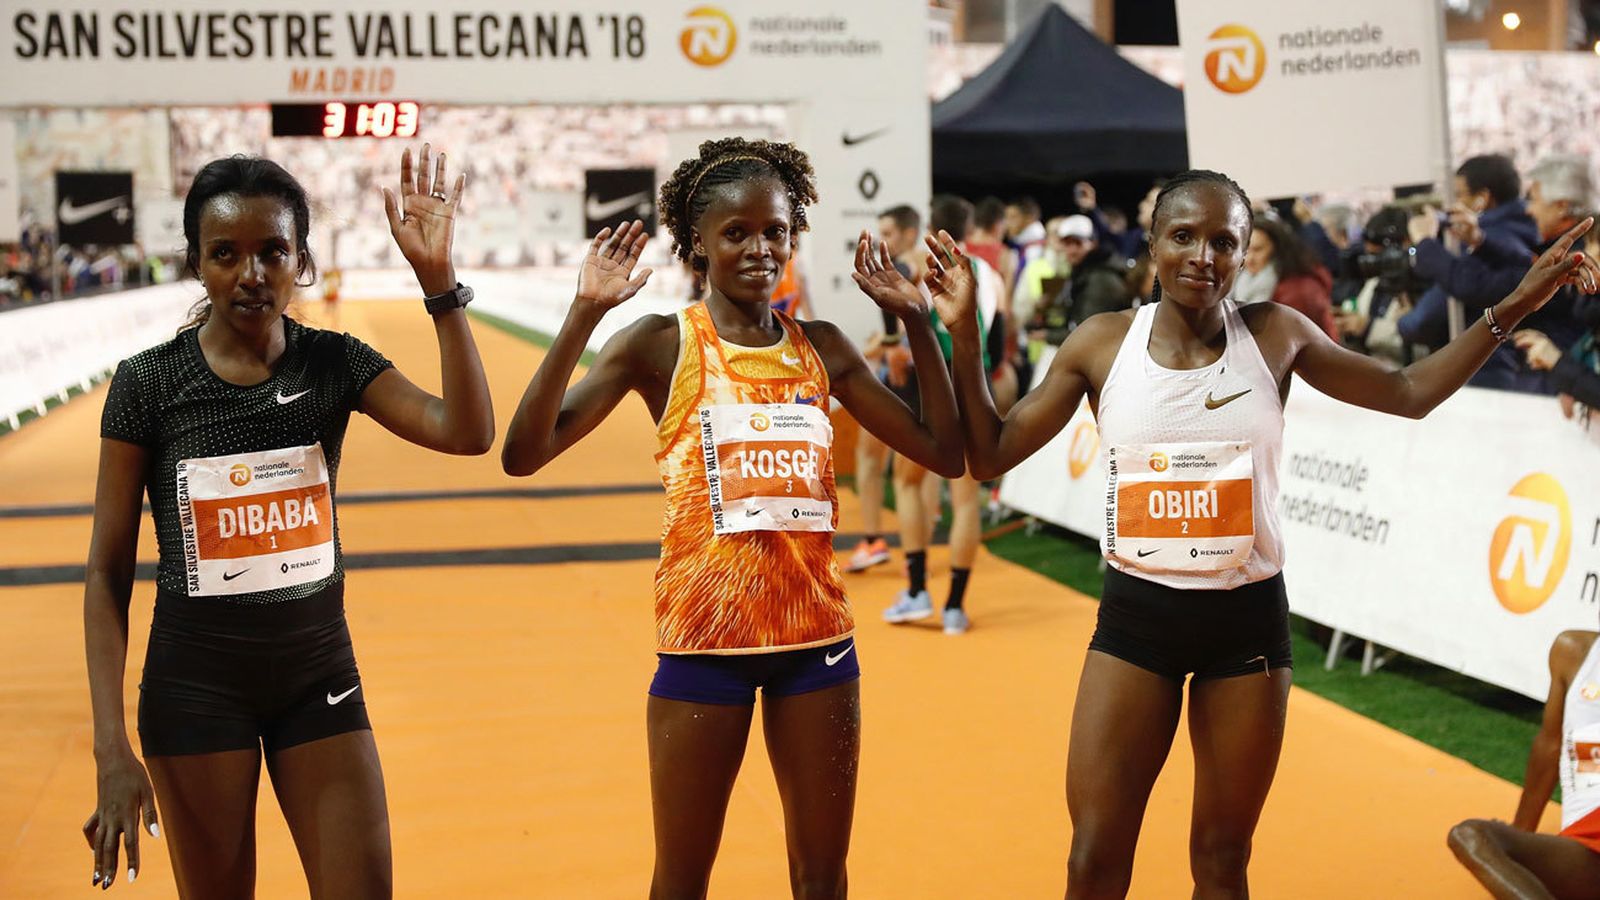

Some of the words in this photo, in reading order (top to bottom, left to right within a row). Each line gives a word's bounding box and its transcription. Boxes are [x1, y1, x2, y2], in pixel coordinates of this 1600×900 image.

[14, 12, 99, 59] SAN
[113, 12, 334, 59] SILVESTRE
[348, 13, 589, 59] VALLECANA
[597, 14, 646, 58] '18
[749, 15, 847, 33] nationale
[1279, 22, 1383, 50] nationale
[749, 36, 881, 56] nederlanden
[1281, 45, 1421, 77] nederlanden
[288, 66, 396, 95] MADRID
[254, 461, 290, 472] nationale
[1172, 453, 1206, 461] nationale
[1172, 460, 1218, 468] nederlanden
[254, 468, 304, 480] nederlanden
[1289, 449, 1369, 492] nationale
[785, 479, 793, 493] 3
[178, 476, 193, 527] VALLECANA
[1149, 490, 1218, 519] OBIRI
[217, 496, 320, 539] DIBABA
[1106, 507, 1116, 548] SILVESTRE
[1181, 521, 1188, 534] 2
[1281, 491, 1390, 545] nederlanden
[184, 528, 198, 573] SILVESTRE
[269, 535, 278, 549] 1
[290, 558, 321, 570] RENAULT
[189, 574, 200, 592] SAN
